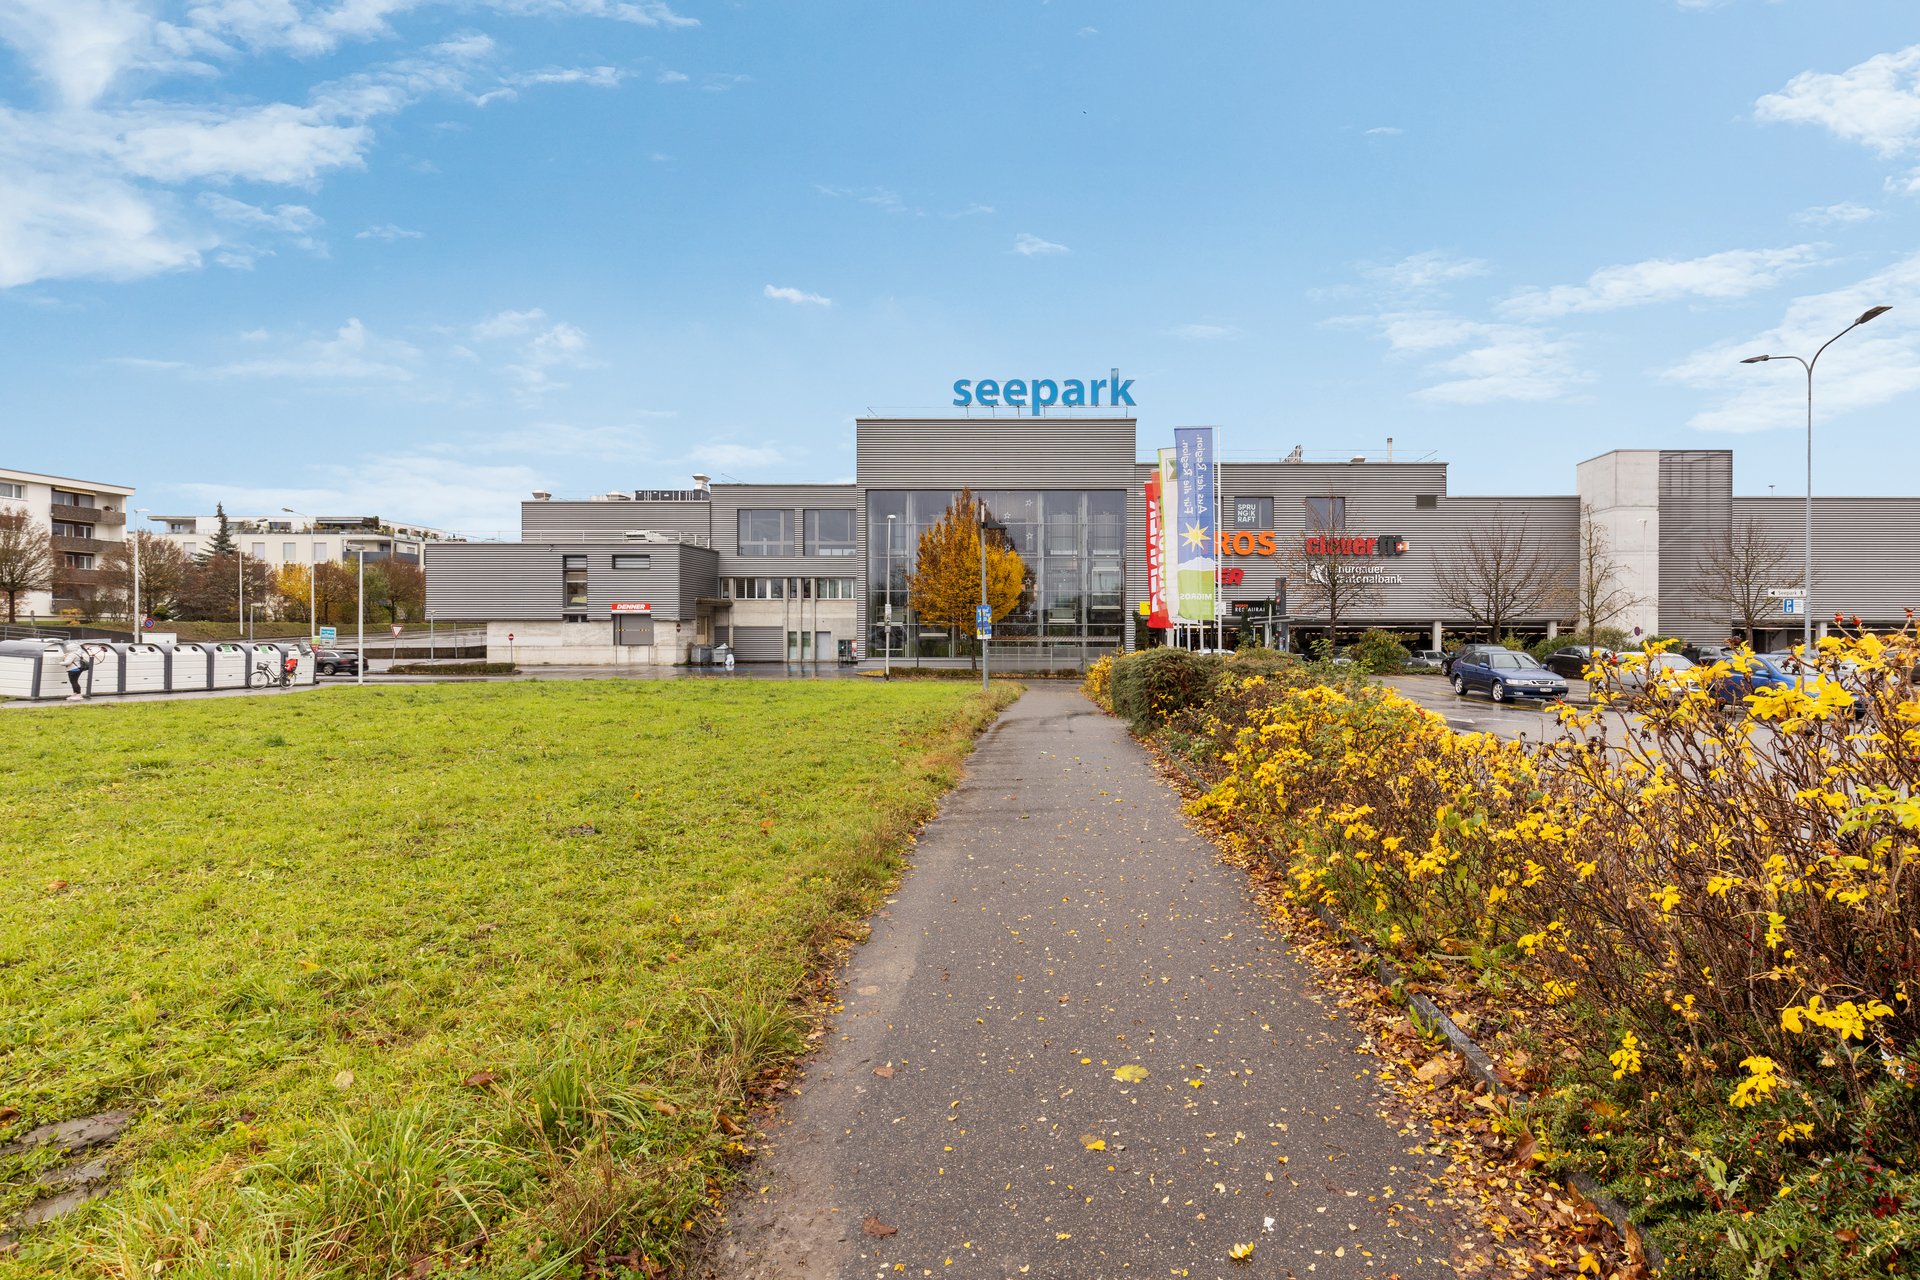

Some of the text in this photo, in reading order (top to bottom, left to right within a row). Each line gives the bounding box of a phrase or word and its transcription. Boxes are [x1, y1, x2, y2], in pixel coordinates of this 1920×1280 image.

[953, 368, 1137, 416] seepark
[1215, 531, 1277, 555] ROS
[1337, 565, 1384, 574] hurgauer
